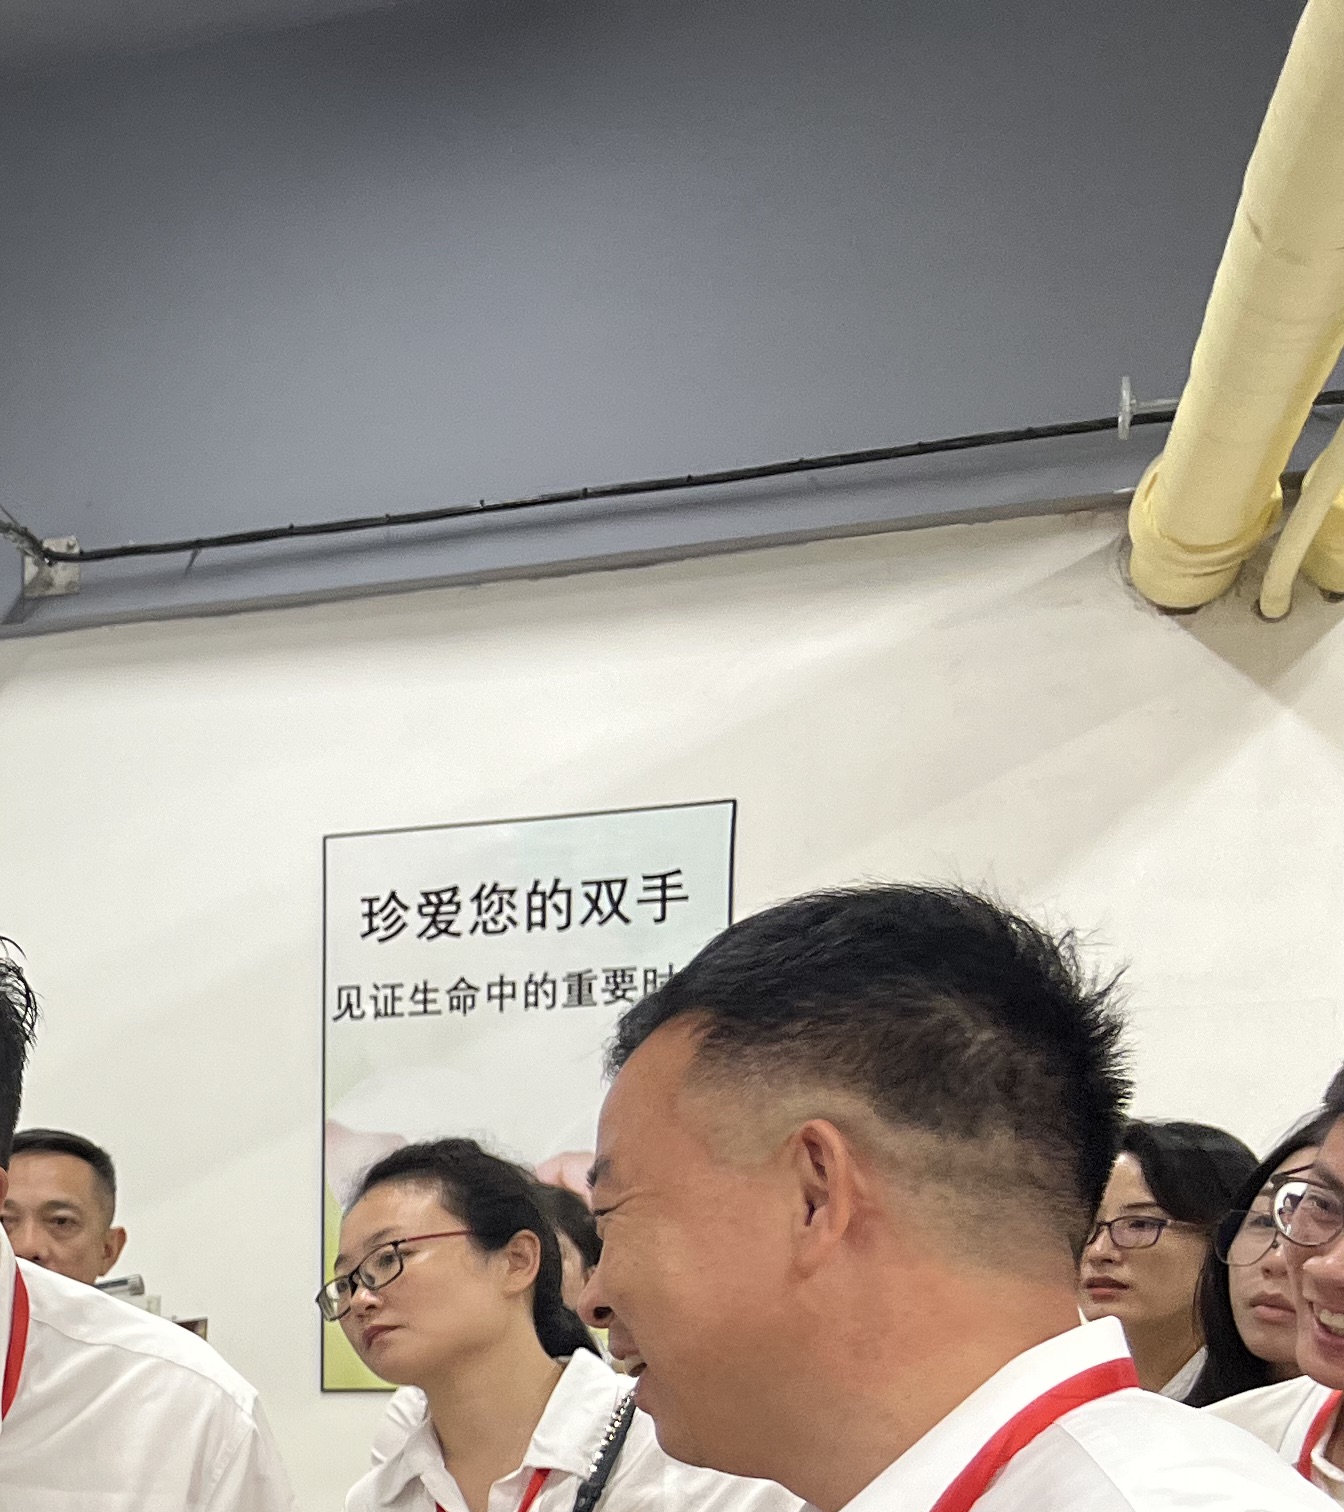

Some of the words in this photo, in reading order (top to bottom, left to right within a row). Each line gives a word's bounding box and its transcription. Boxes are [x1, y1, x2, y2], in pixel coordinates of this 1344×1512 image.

[360, 868, 690, 944] 珍爱您的双手
